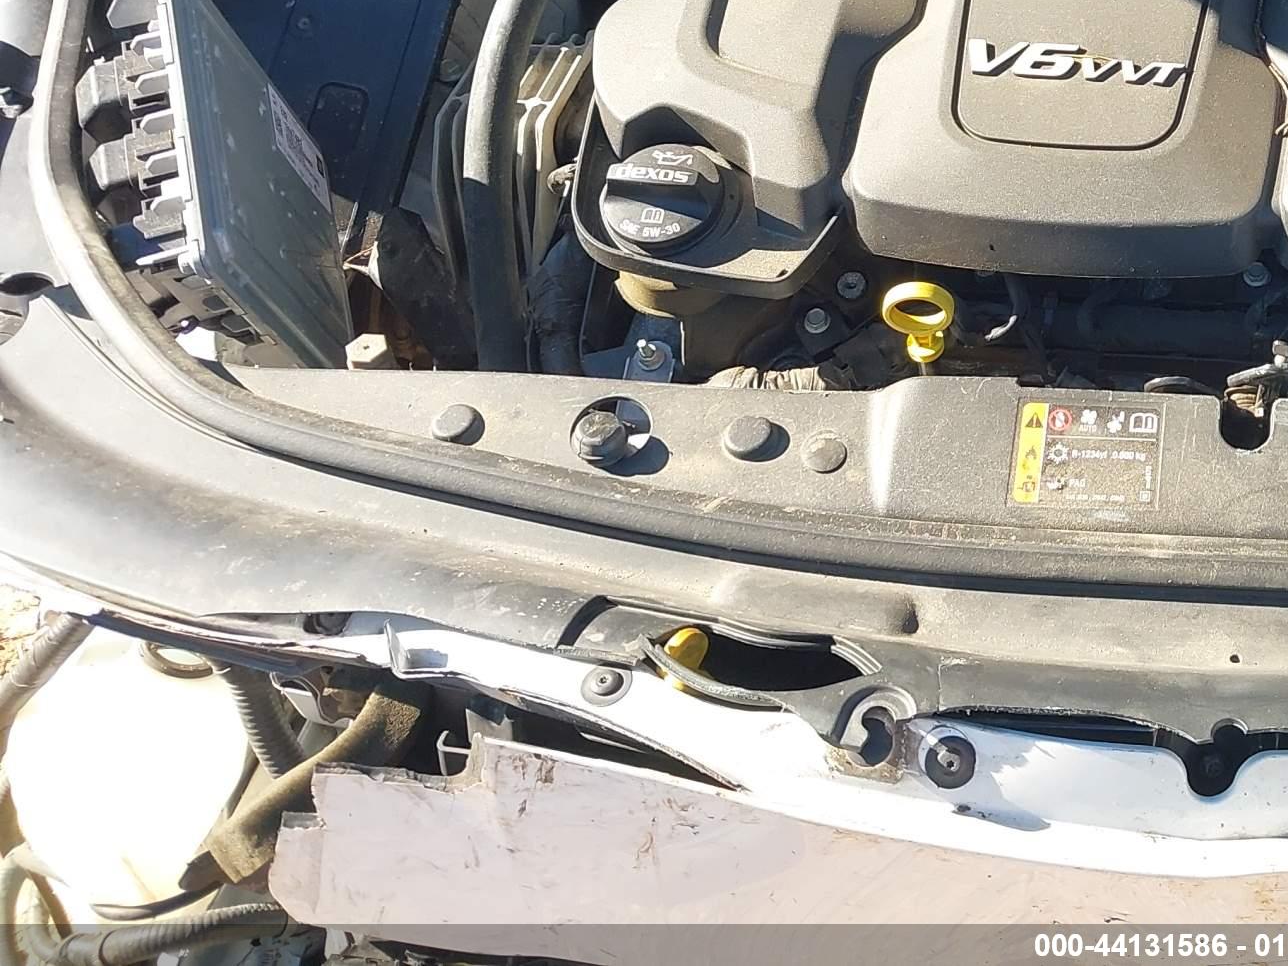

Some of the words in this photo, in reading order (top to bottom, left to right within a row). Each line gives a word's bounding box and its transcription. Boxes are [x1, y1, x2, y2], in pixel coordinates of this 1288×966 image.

[967, 37, 1084, 80] V6
[1082, 58, 1188, 87] VVT
[615, 162, 692, 184] dexos
[618, 218, 641, 236] SAE
[642, 221, 681, 239] 5W-30
